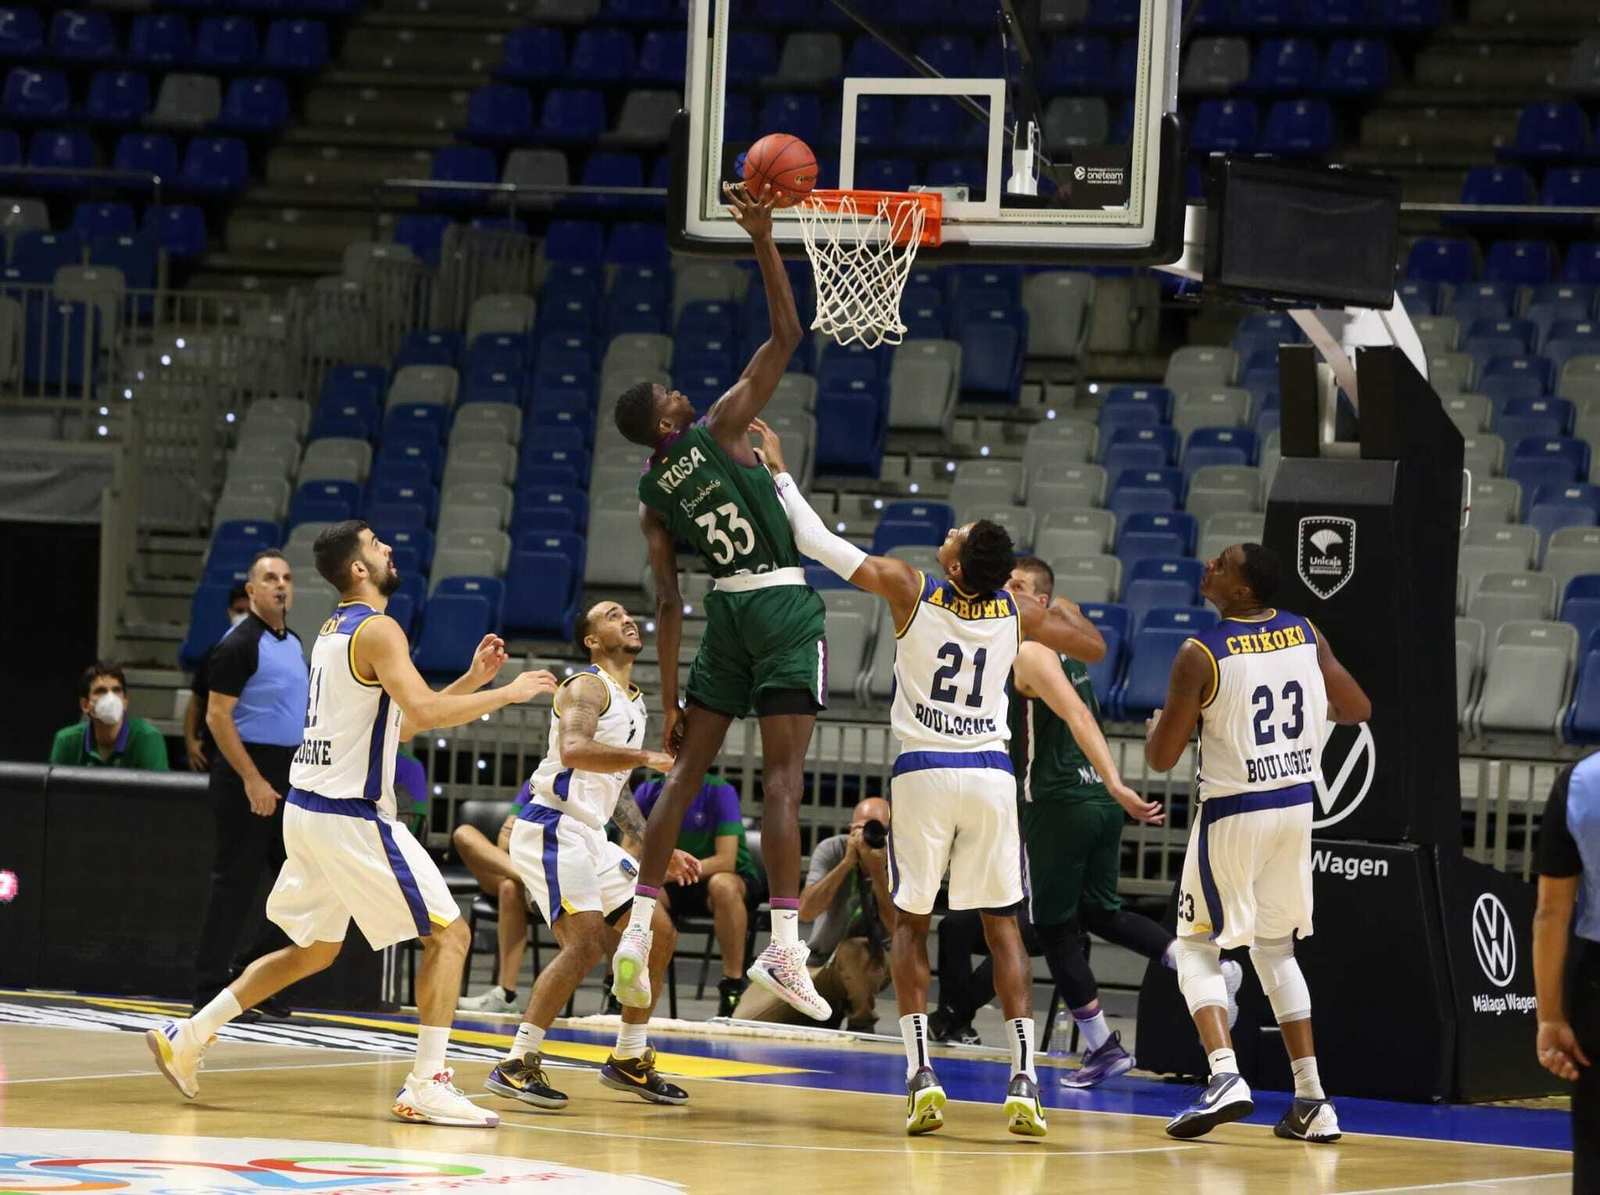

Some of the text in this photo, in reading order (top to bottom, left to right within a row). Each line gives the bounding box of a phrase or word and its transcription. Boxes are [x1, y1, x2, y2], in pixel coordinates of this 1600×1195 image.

[1087, 171, 1124, 180] oneteam
[656, 446, 707, 495] NZOSA
[694, 501, 756, 565] 33
[1309, 555, 1342, 568] Unicaja
[1225, 625, 1306, 655] CHIKOKO
[930, 641, 987, 708] 21
[914, 702, 997, 736] BOULOGNE
[1251, 680, 1304, 746] 23
[1245, 748, 1313, 784] BOULOGNE
[1312, 850, 1389, 881] Wagen
[1472, 992, 1538, 1016] Málaga Wagen
